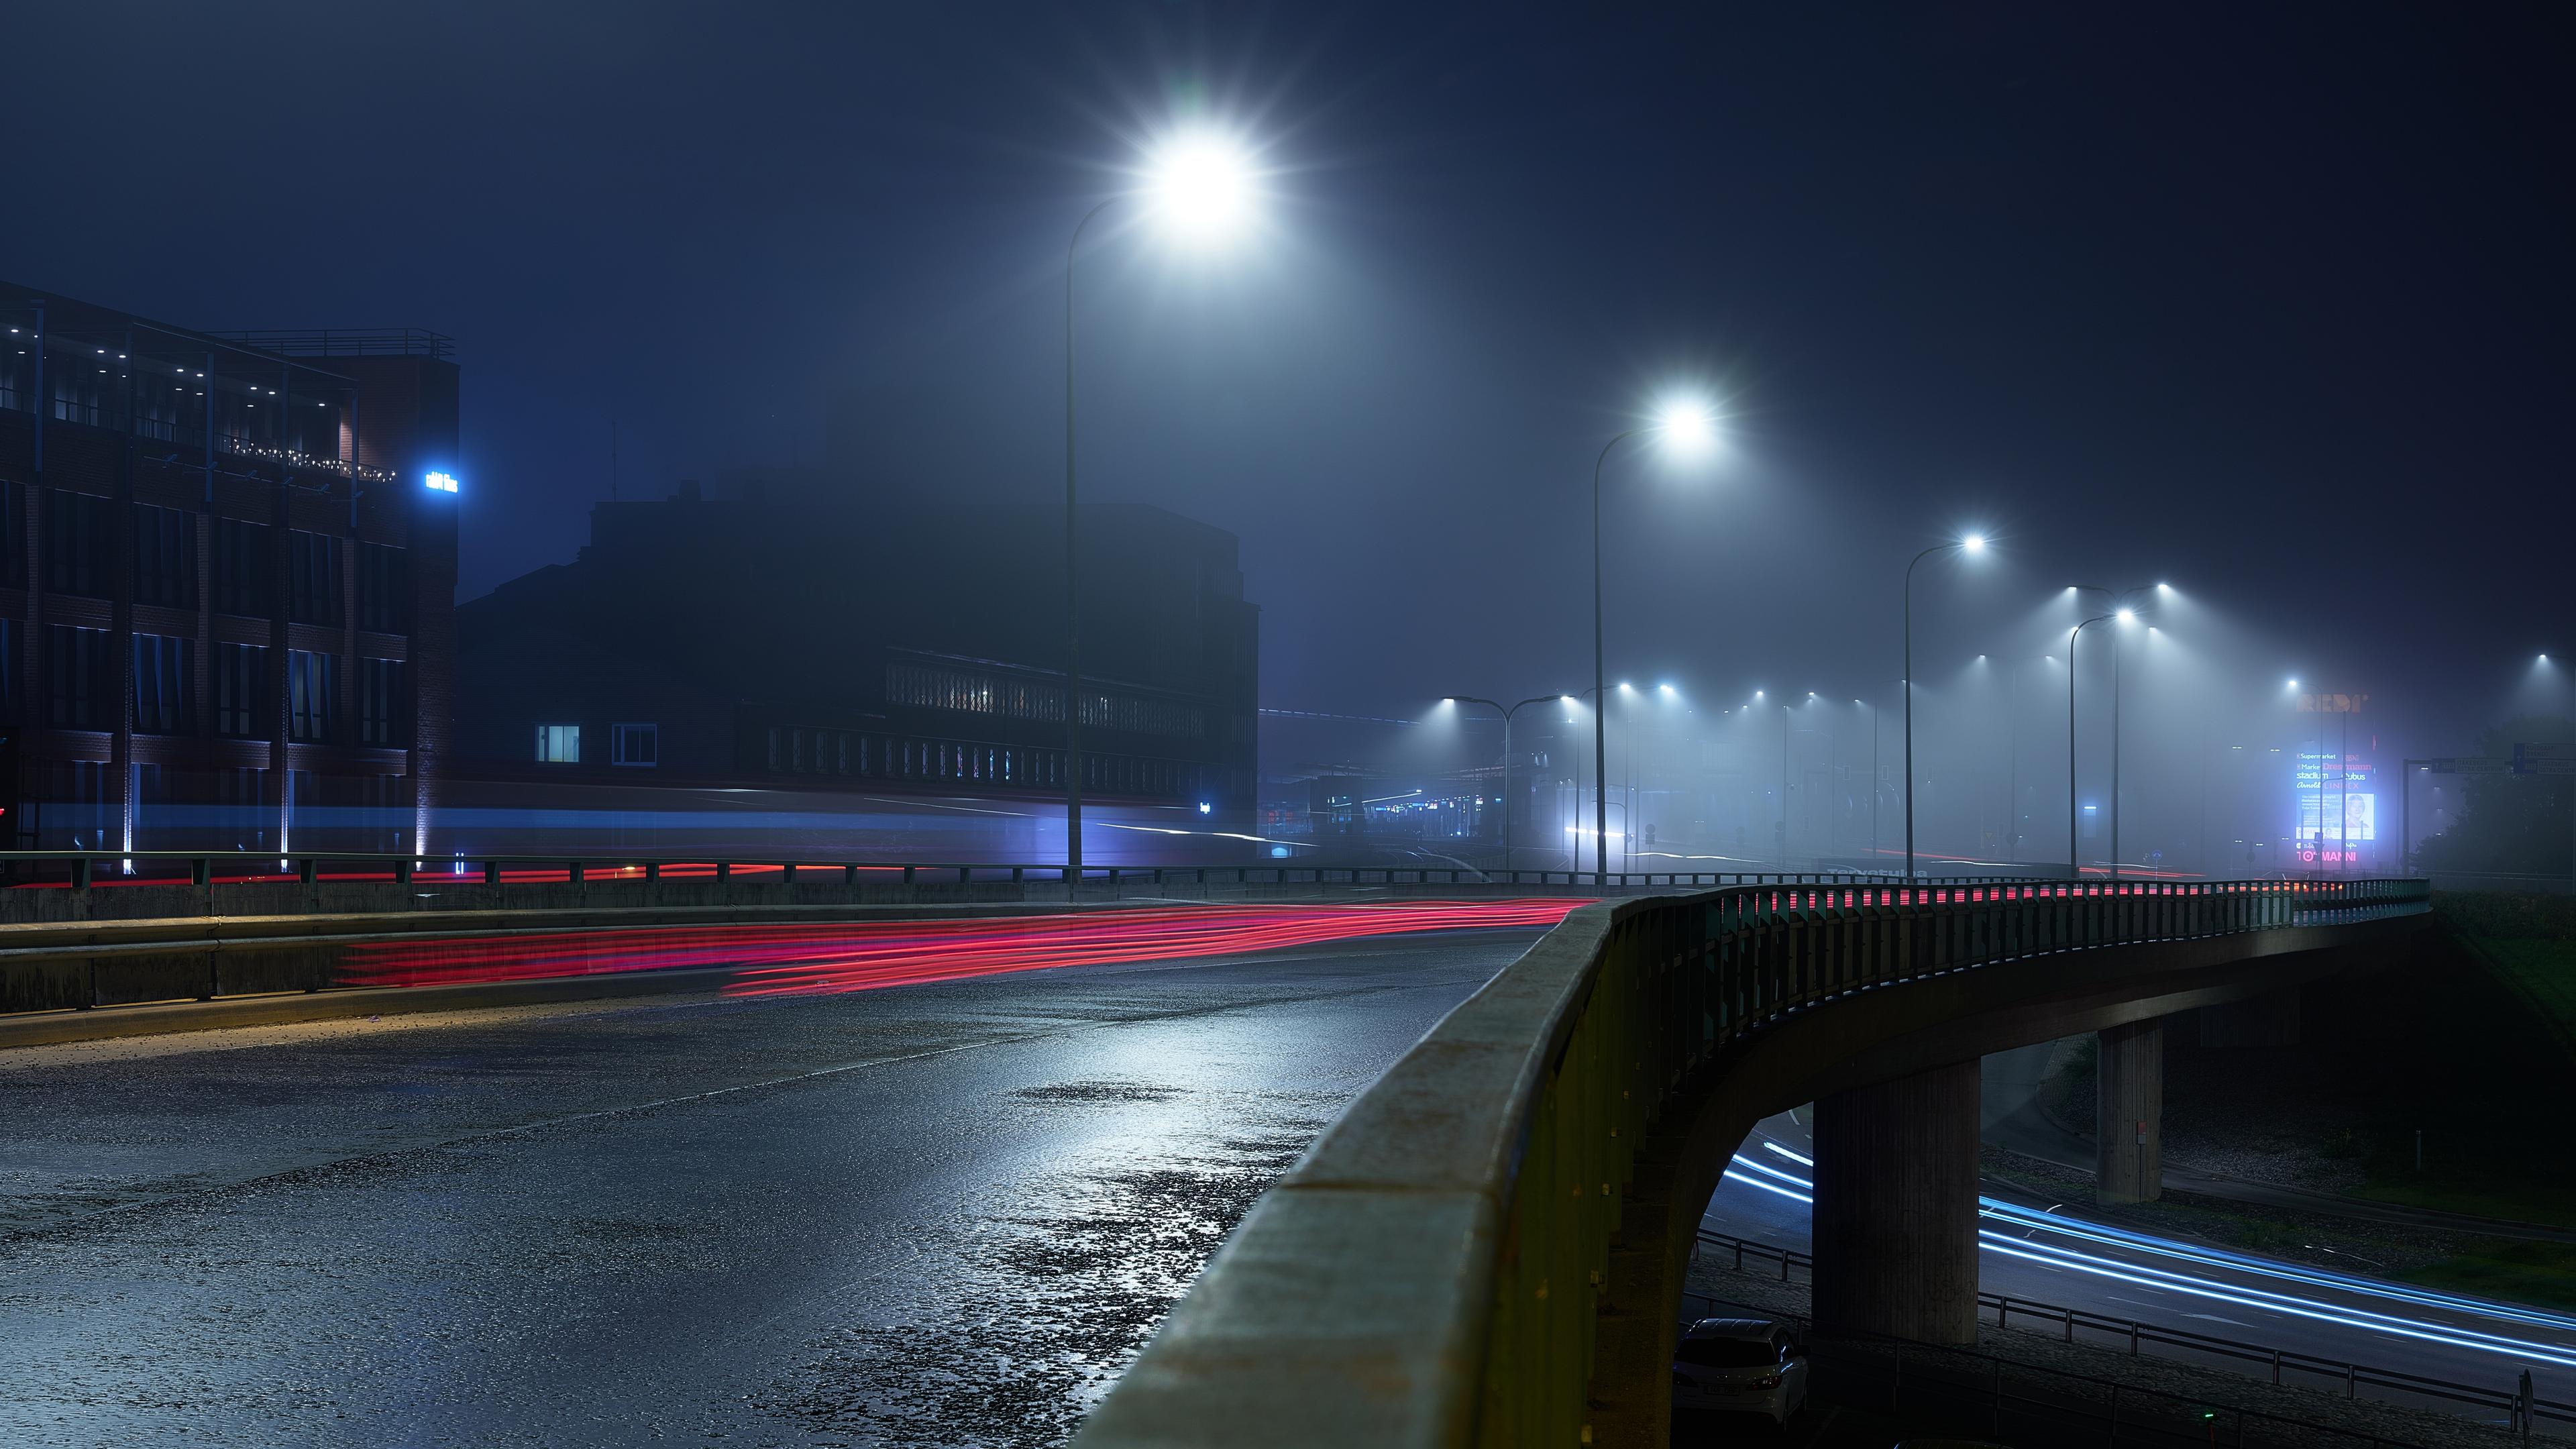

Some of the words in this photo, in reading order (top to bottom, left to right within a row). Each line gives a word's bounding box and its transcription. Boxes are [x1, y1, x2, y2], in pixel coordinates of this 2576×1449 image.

[2296, 694, 2361, 713] REDI
[2297, 851, 2356, 862] TOMANNI
[1827, 868, 1927, 877] Tervetula
